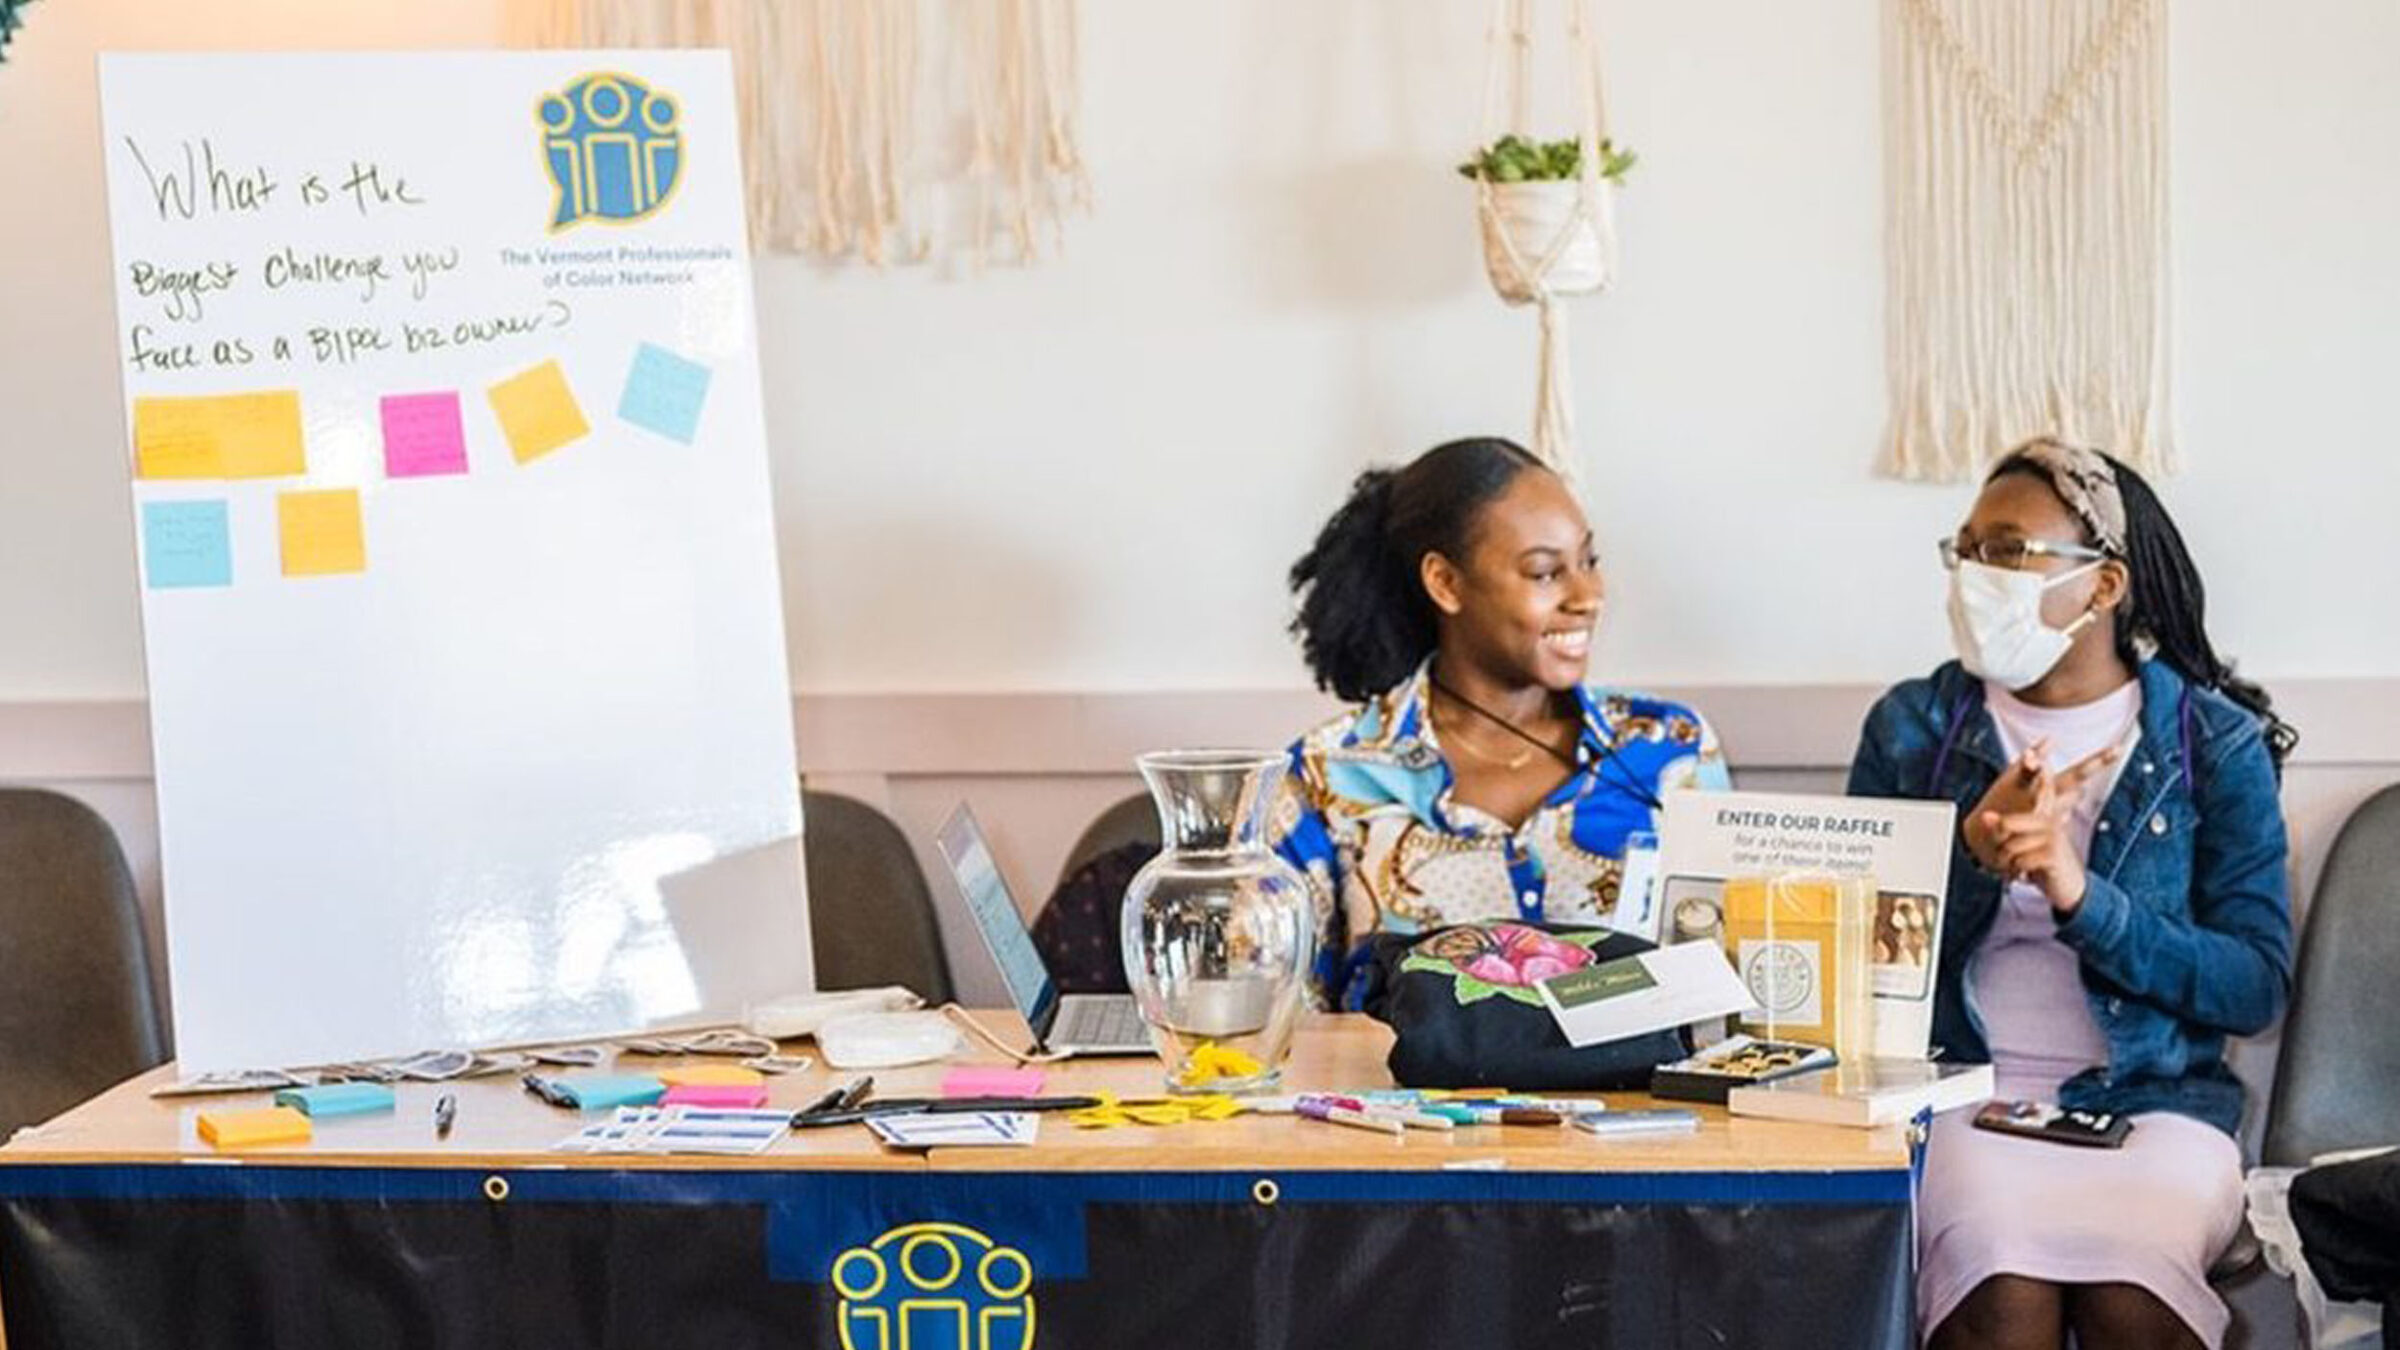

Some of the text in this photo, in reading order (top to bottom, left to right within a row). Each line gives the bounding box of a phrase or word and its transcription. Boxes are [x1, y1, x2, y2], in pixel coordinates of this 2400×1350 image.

[126, 135, 426, 221] What is the
[502, 245, 733, 265] The Vermont Professionals
[403, 248, 459, 301] you
[543, 268, 694, 288] of Color Network
[130, 325, 201, 372] face
[213, 339, 254, 364] as
[274, 337, 292, 361] a
[1717, 809, 1894, 837] ENTER OUR RAFFLE
[1735, 834, 1873, 855] for a chance to win
[1765, 851, 1780, 864] of
